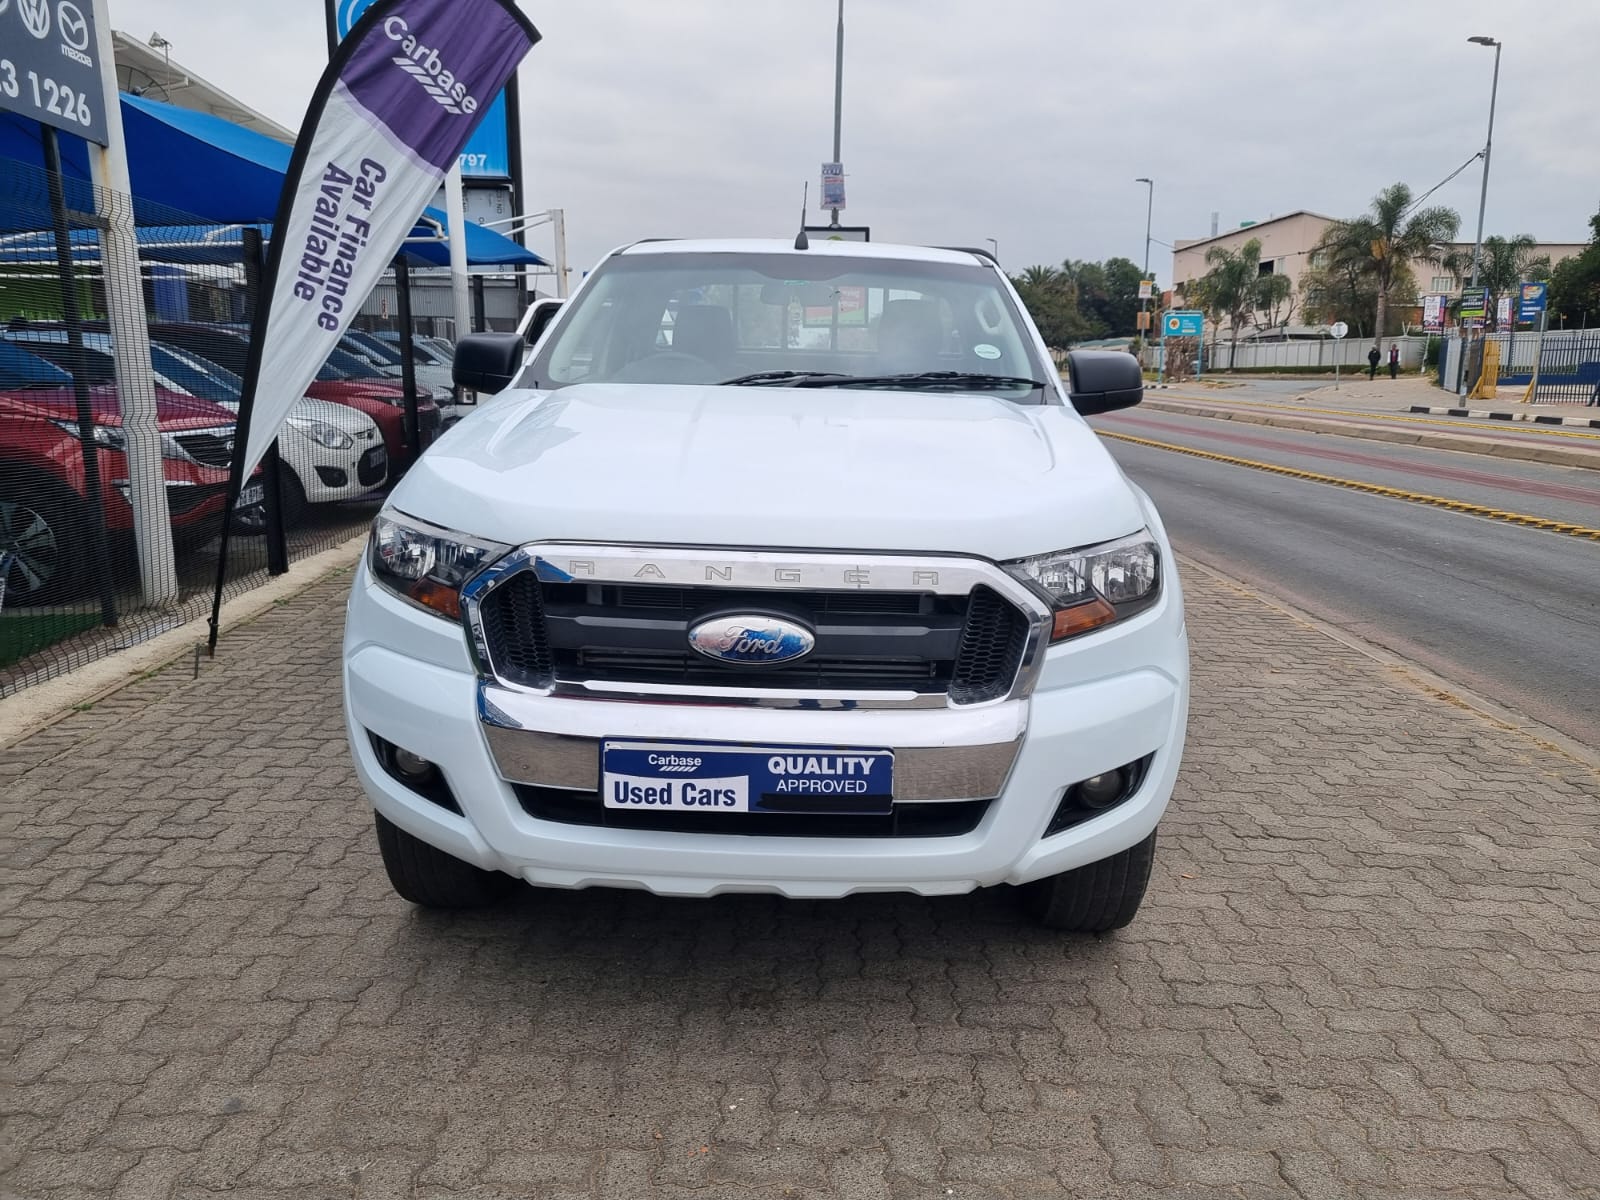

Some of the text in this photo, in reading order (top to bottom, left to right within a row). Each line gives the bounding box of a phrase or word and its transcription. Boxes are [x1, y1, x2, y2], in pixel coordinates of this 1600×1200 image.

[19, 0, 49, 37] W
[61, 43, 93, 68] mazda
[384, 15, 478, 114] Carbase
[0, 59, 92, 127] 3 1226
[293, 161, 354, 302] Available
[317, 158, 387, 332] Car Finance
[568, 559, 940, 586] RANGER
[719, 625, 784, 656] Ford
[647, 753, 702, 767] Carbase
[767, 757, 876, 776] QUALITY
[613, 780, 737, 808] Used Cars
[776, 779, 868, 794] APPROVED
